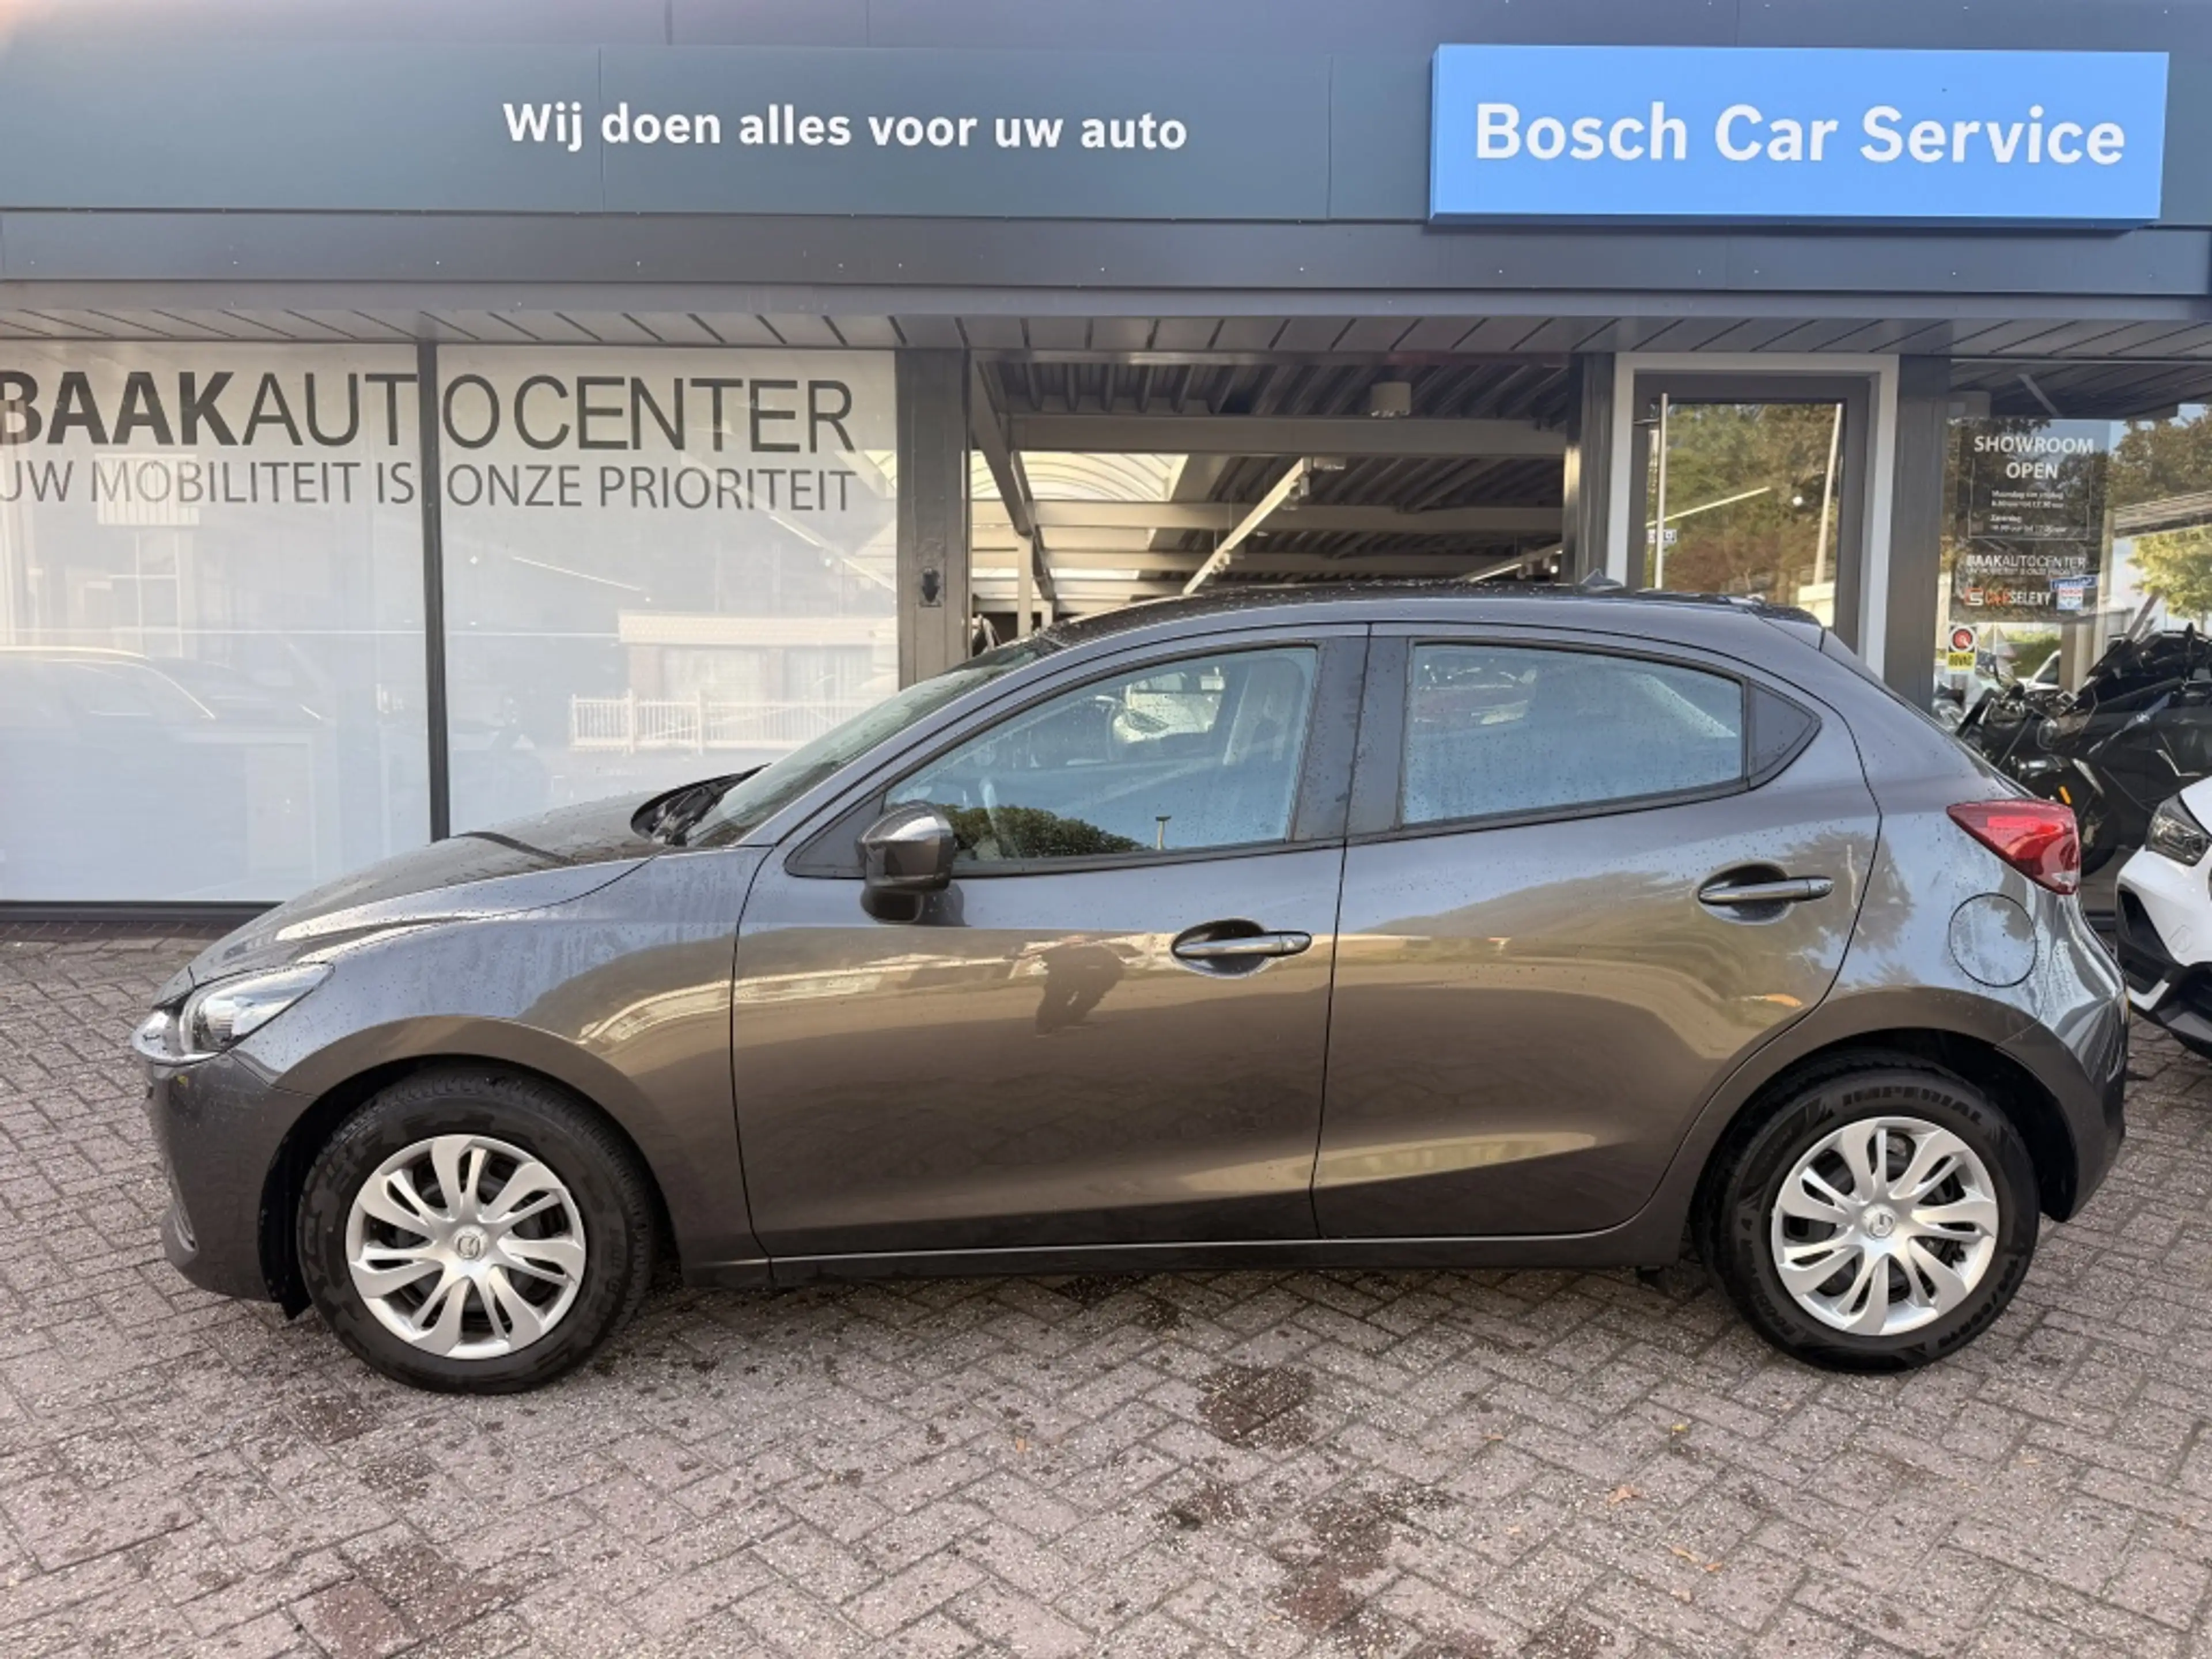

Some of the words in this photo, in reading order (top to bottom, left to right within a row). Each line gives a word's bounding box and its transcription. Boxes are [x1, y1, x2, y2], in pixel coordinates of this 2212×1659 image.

[503, 102, 582, 152] Wij
[602, 103, 721, 143] doen
[740, 104, 851, 145] alles
[868, 117, 978, 146] voor
[995, 118, 1063, 147] uw
[1081, 113, 1187, 149] auto
[1476, 101, 1687, 161] Bosch
[1715, 104, 1839, 161] Car
[1860, 105, 2125, 164] Service
[1974, 436, 2094, 454] SHOWROOM
[0, 460, 74, 502] UW
[91, 461, 361, 503] MOBILITEIT
[377, 462, 415, 504] IS
[446, 464, 582, 507] ONZE
[600, 466, 857, 512] PRIORITEIT
[2006, 463, 2059, 479] OPEN
